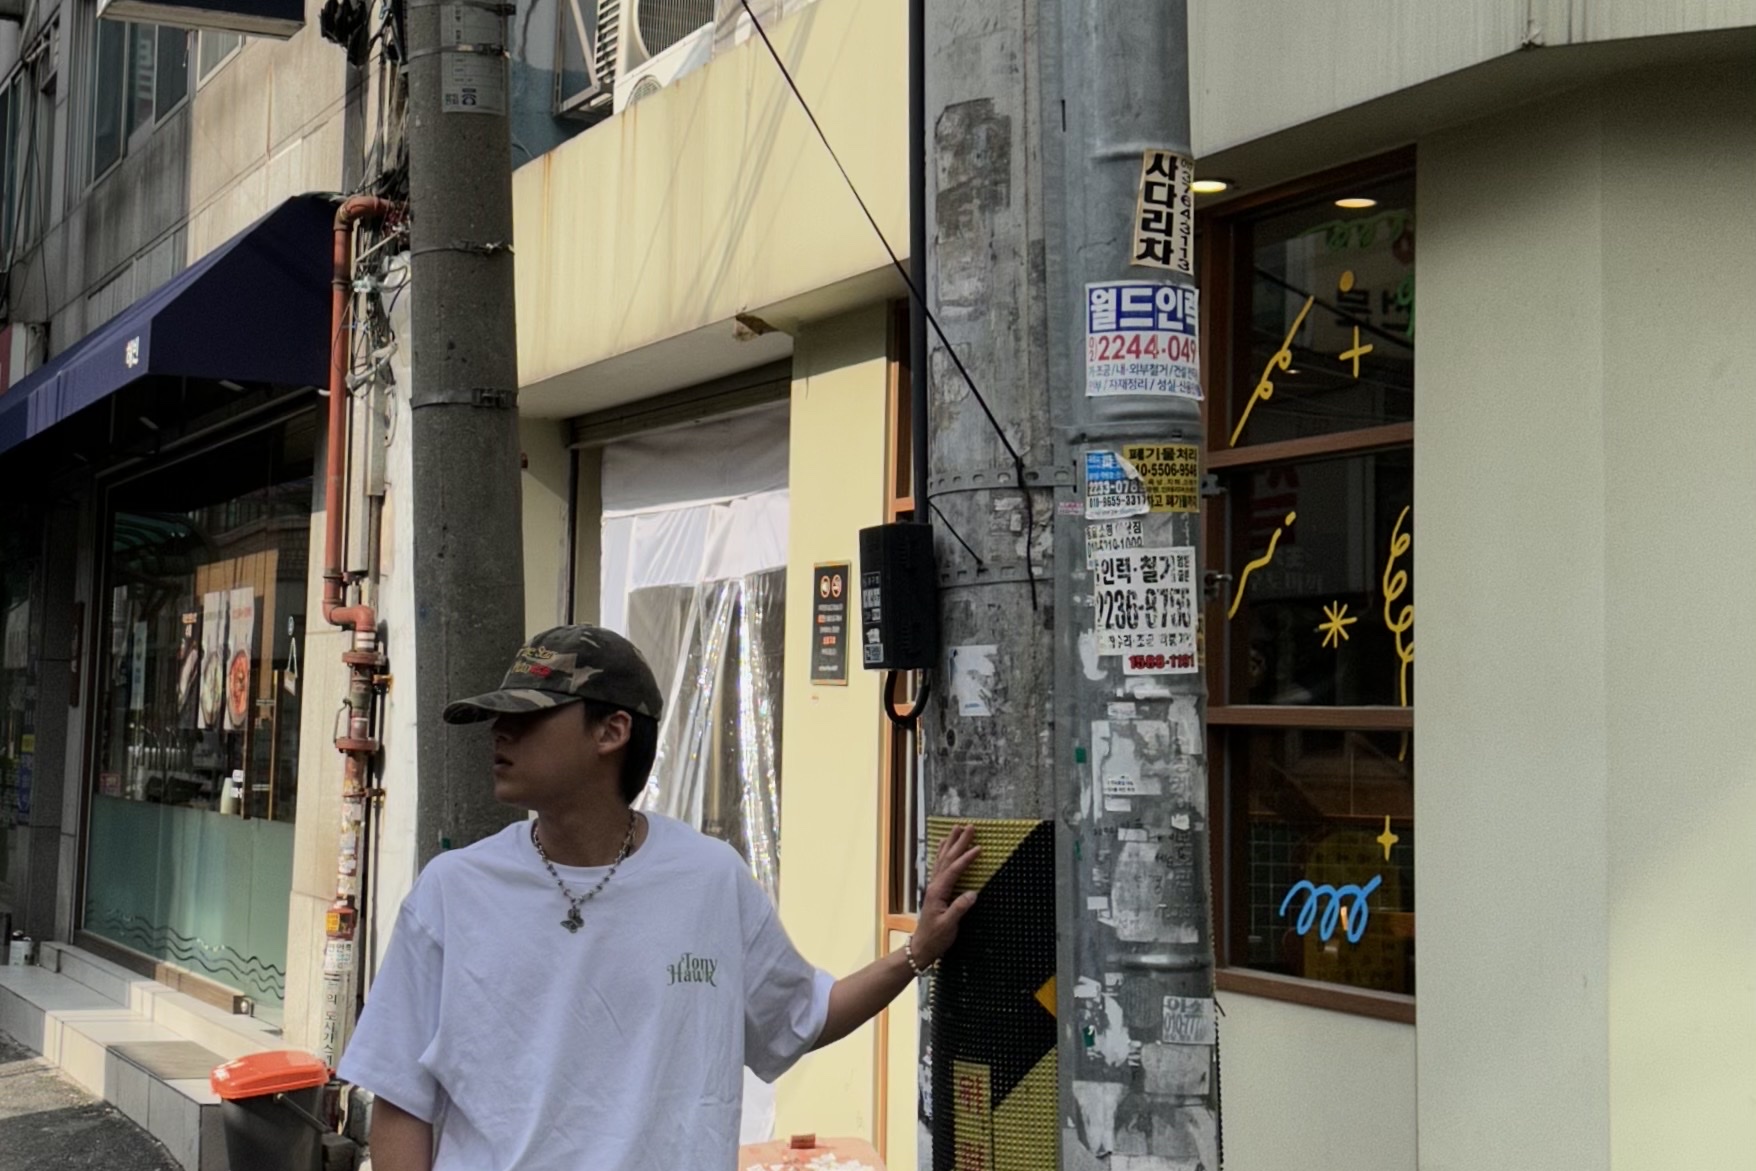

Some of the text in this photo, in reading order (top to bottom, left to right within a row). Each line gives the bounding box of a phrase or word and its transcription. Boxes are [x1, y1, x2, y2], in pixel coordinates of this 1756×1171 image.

[1136, 152, 1178, 265] 사다리차
[680, 952, 718, 975] Tony
[666, 964, 717, 988] Hawk
